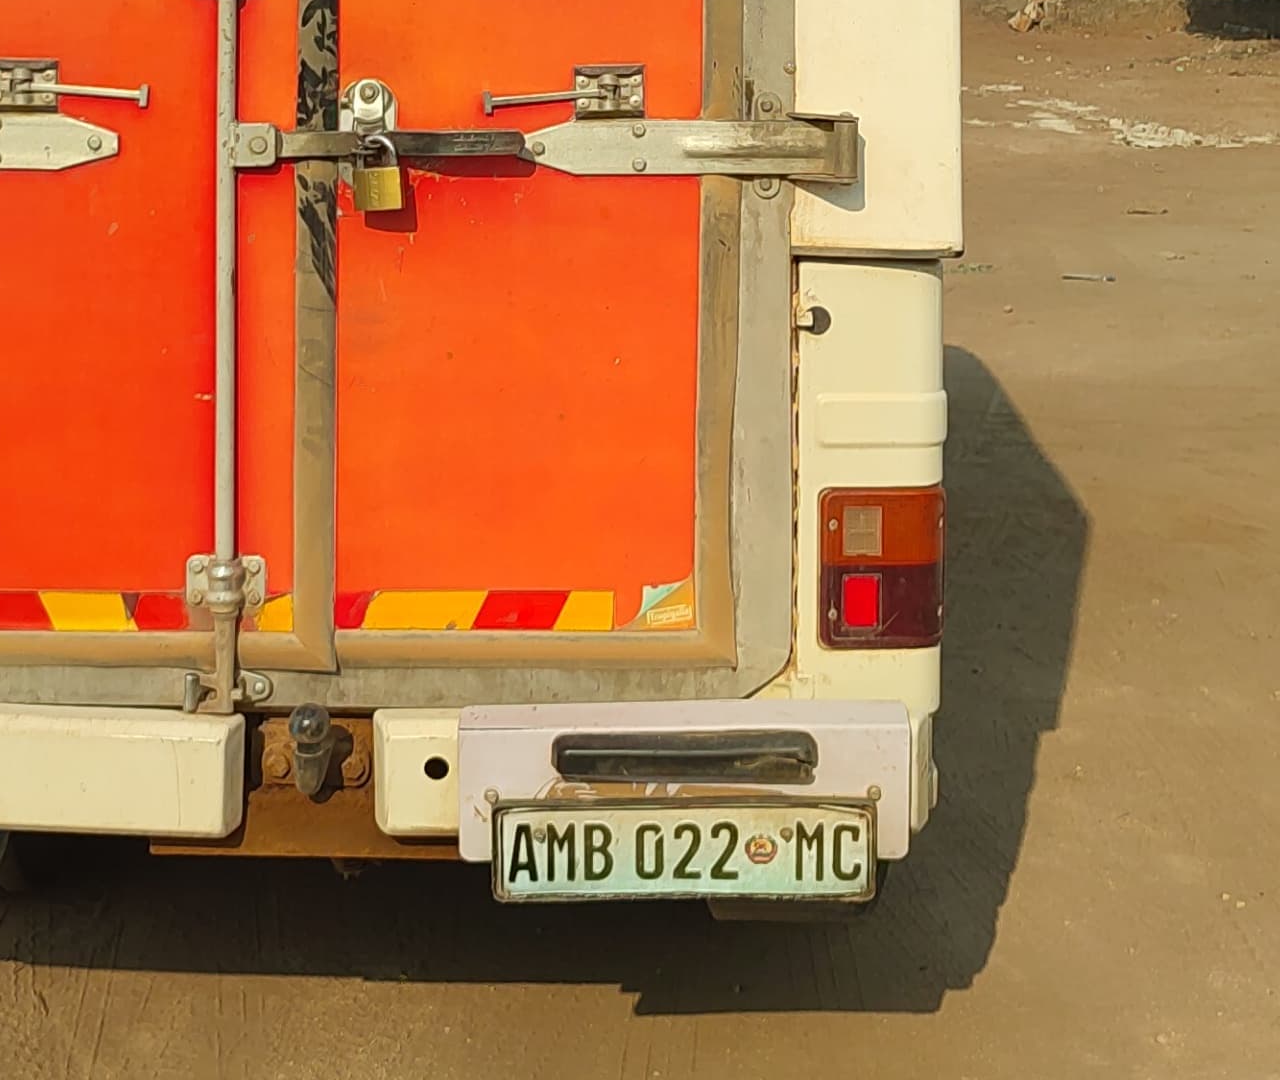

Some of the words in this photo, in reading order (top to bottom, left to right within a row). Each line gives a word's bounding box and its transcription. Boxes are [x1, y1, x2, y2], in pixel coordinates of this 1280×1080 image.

[509, 821, 614, 882] AMB
[635, 821, 738, 880] 022
[796, 821, 861, 881] MC
